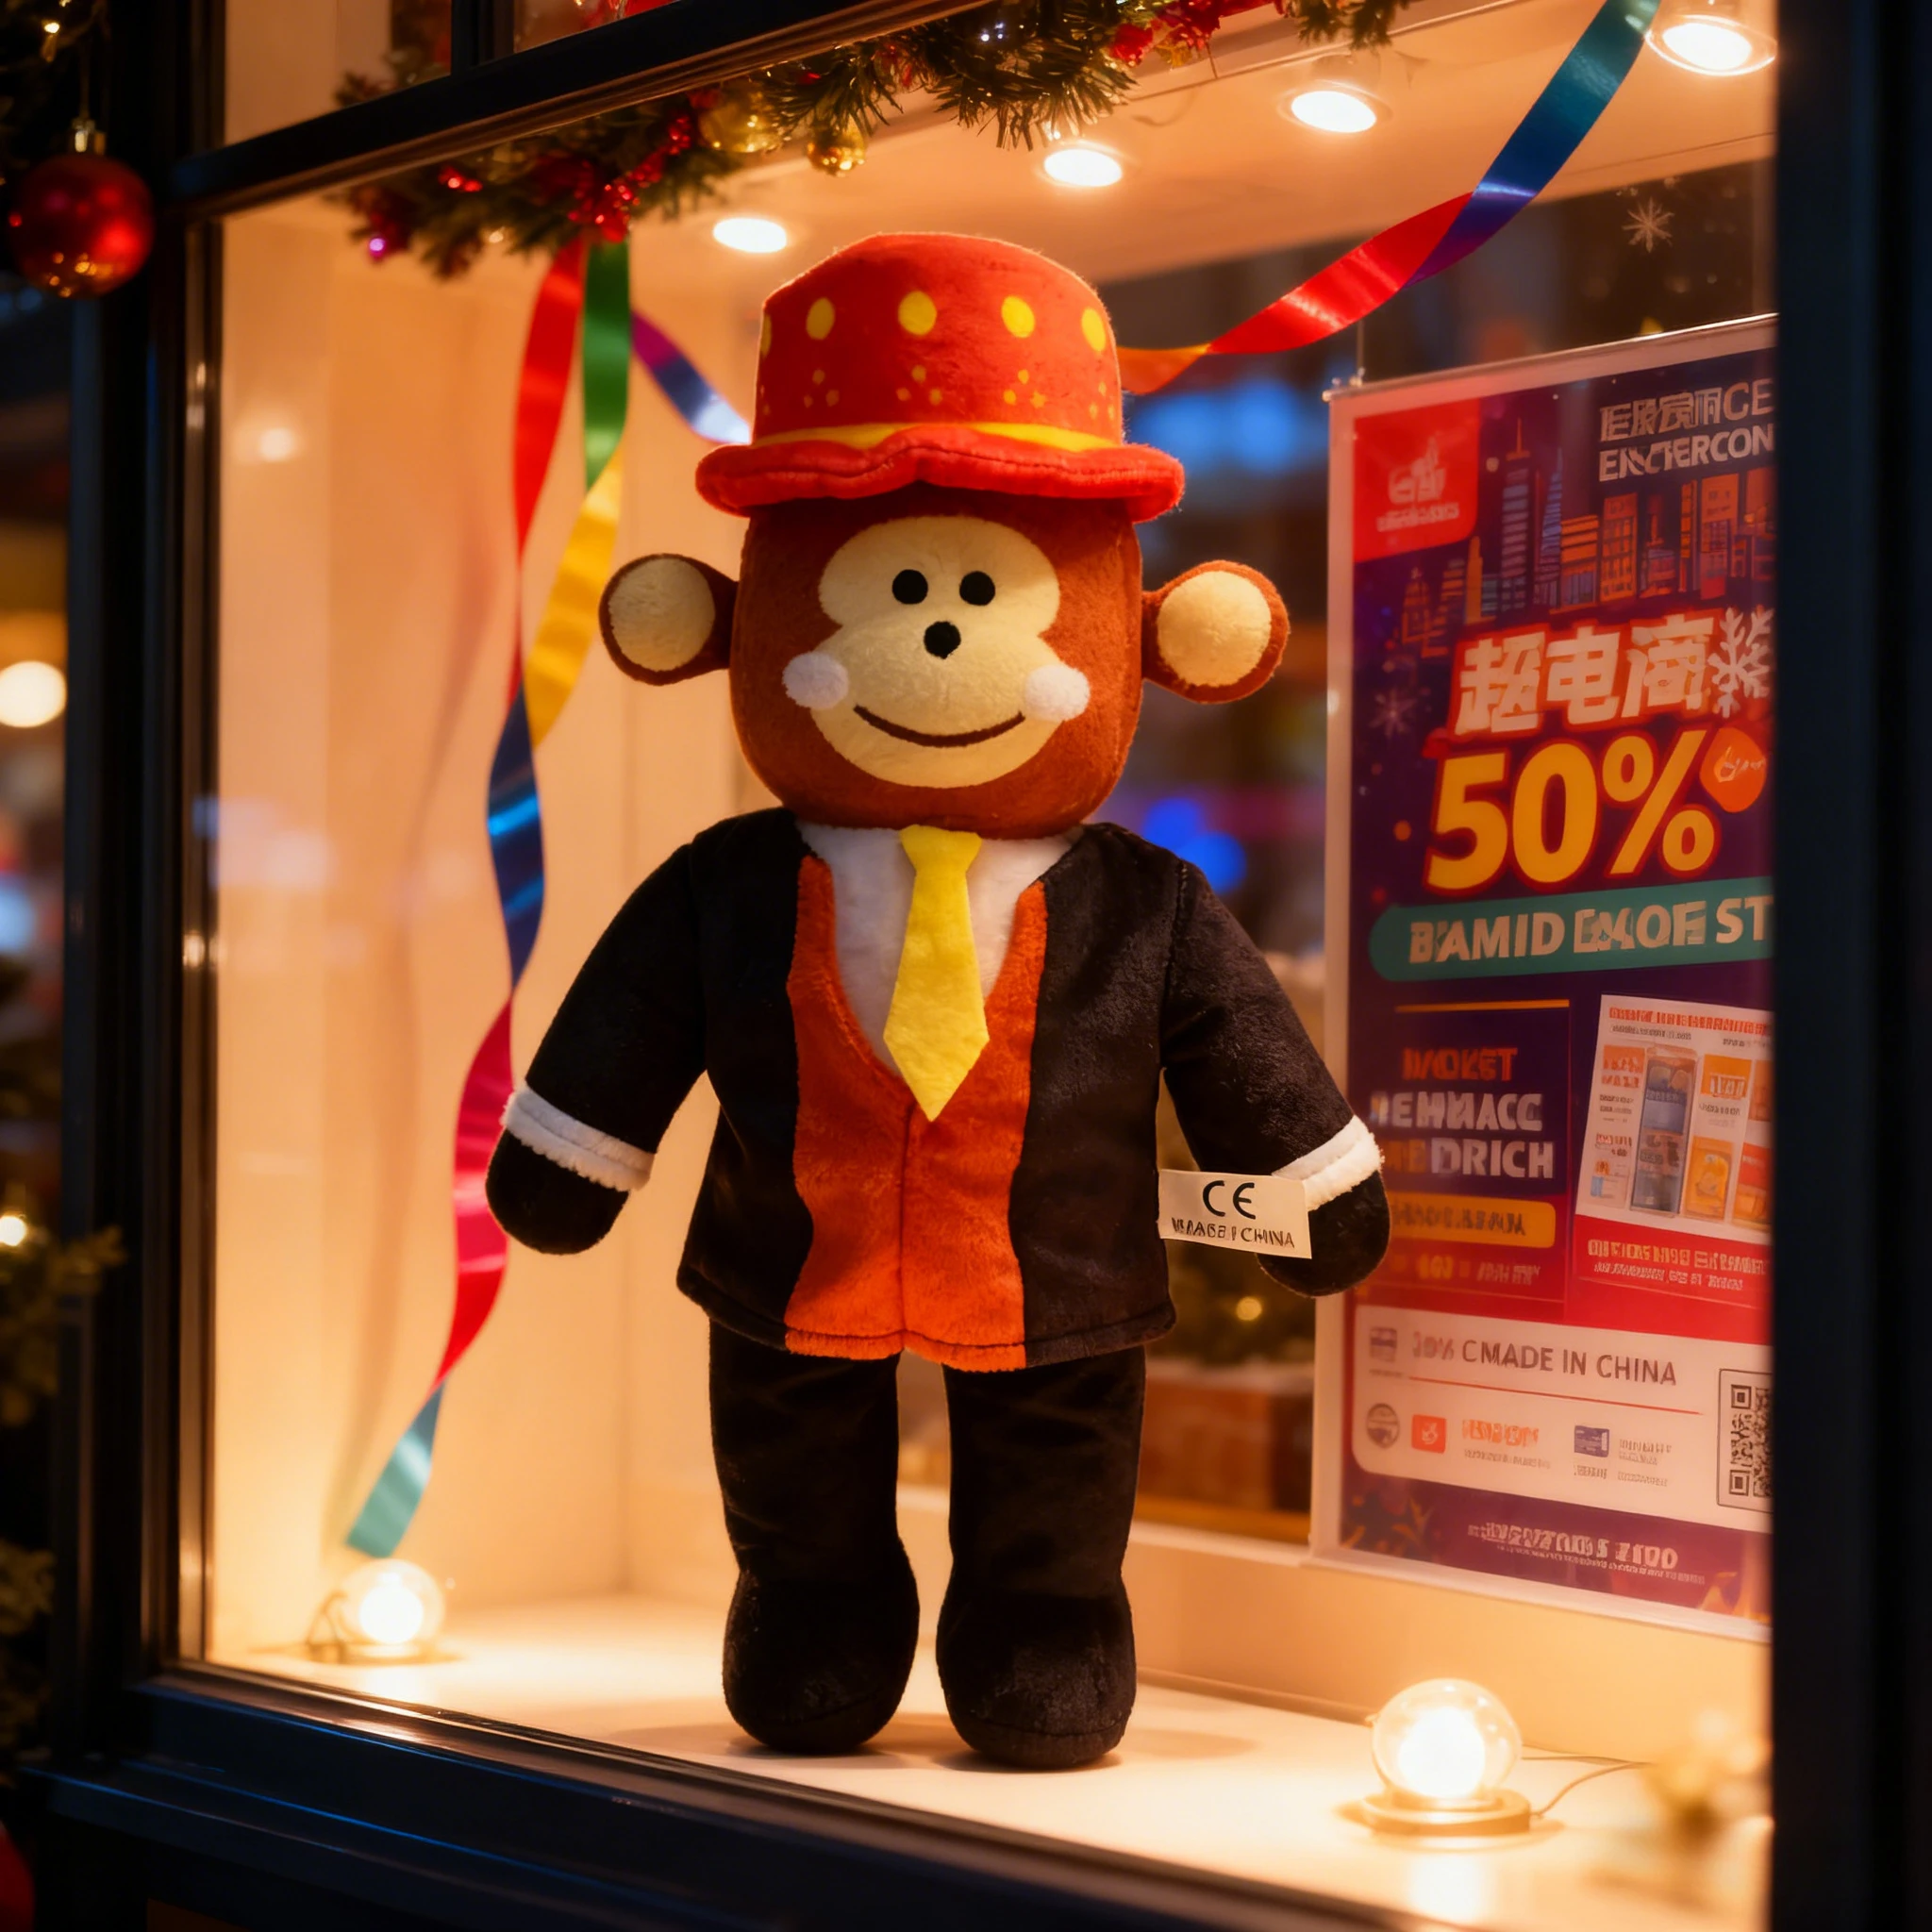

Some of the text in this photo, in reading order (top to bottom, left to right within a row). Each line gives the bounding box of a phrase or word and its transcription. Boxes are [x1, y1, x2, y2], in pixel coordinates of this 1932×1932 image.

[1425, 730, 1717, 891] 50%
[1202, 1179, 1257, 1220] CE
[1562, 1349, 1588, 1376] IN
[1596, 1354, 1676, 1386] CHINA
